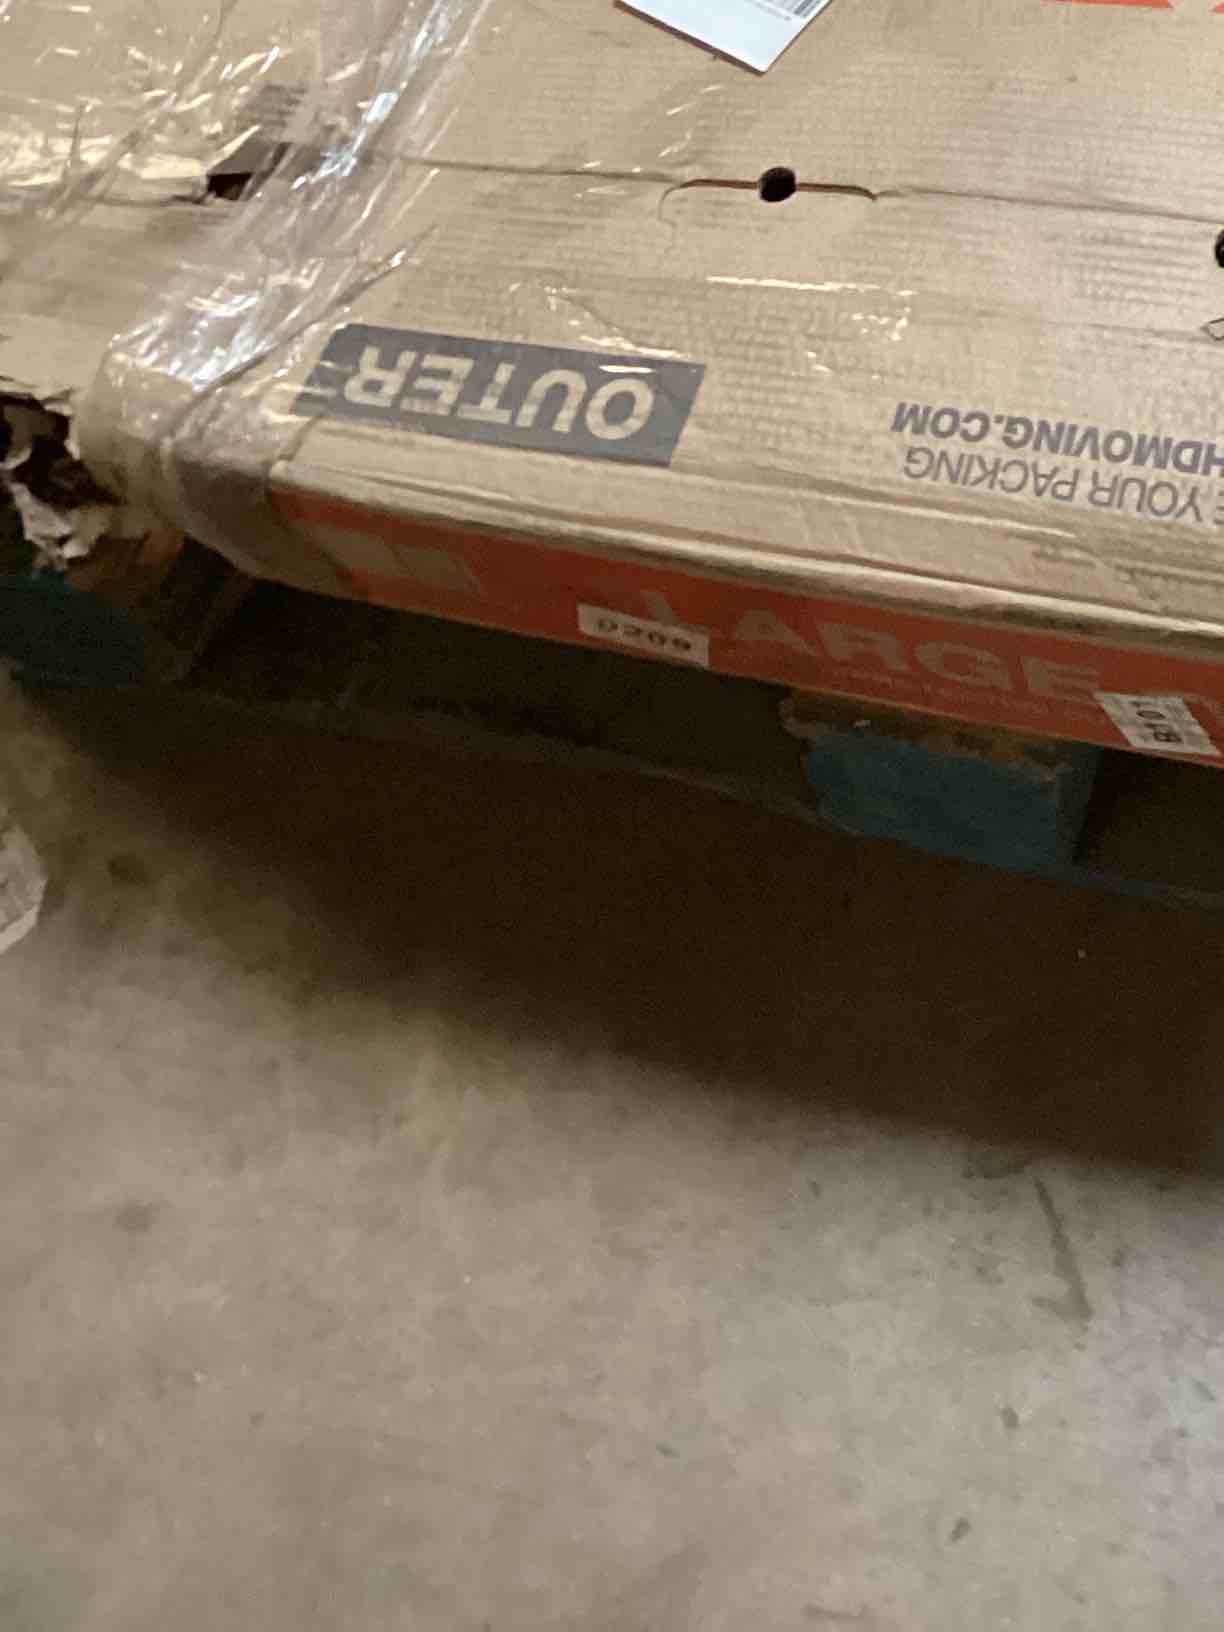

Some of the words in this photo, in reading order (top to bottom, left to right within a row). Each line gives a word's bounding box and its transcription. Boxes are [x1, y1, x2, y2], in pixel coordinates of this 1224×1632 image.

[343, 345, 655, 440] OUTER
[903, 446, 1080, 502] PACKING
[1088, 471, 1202, 522] YOUR
